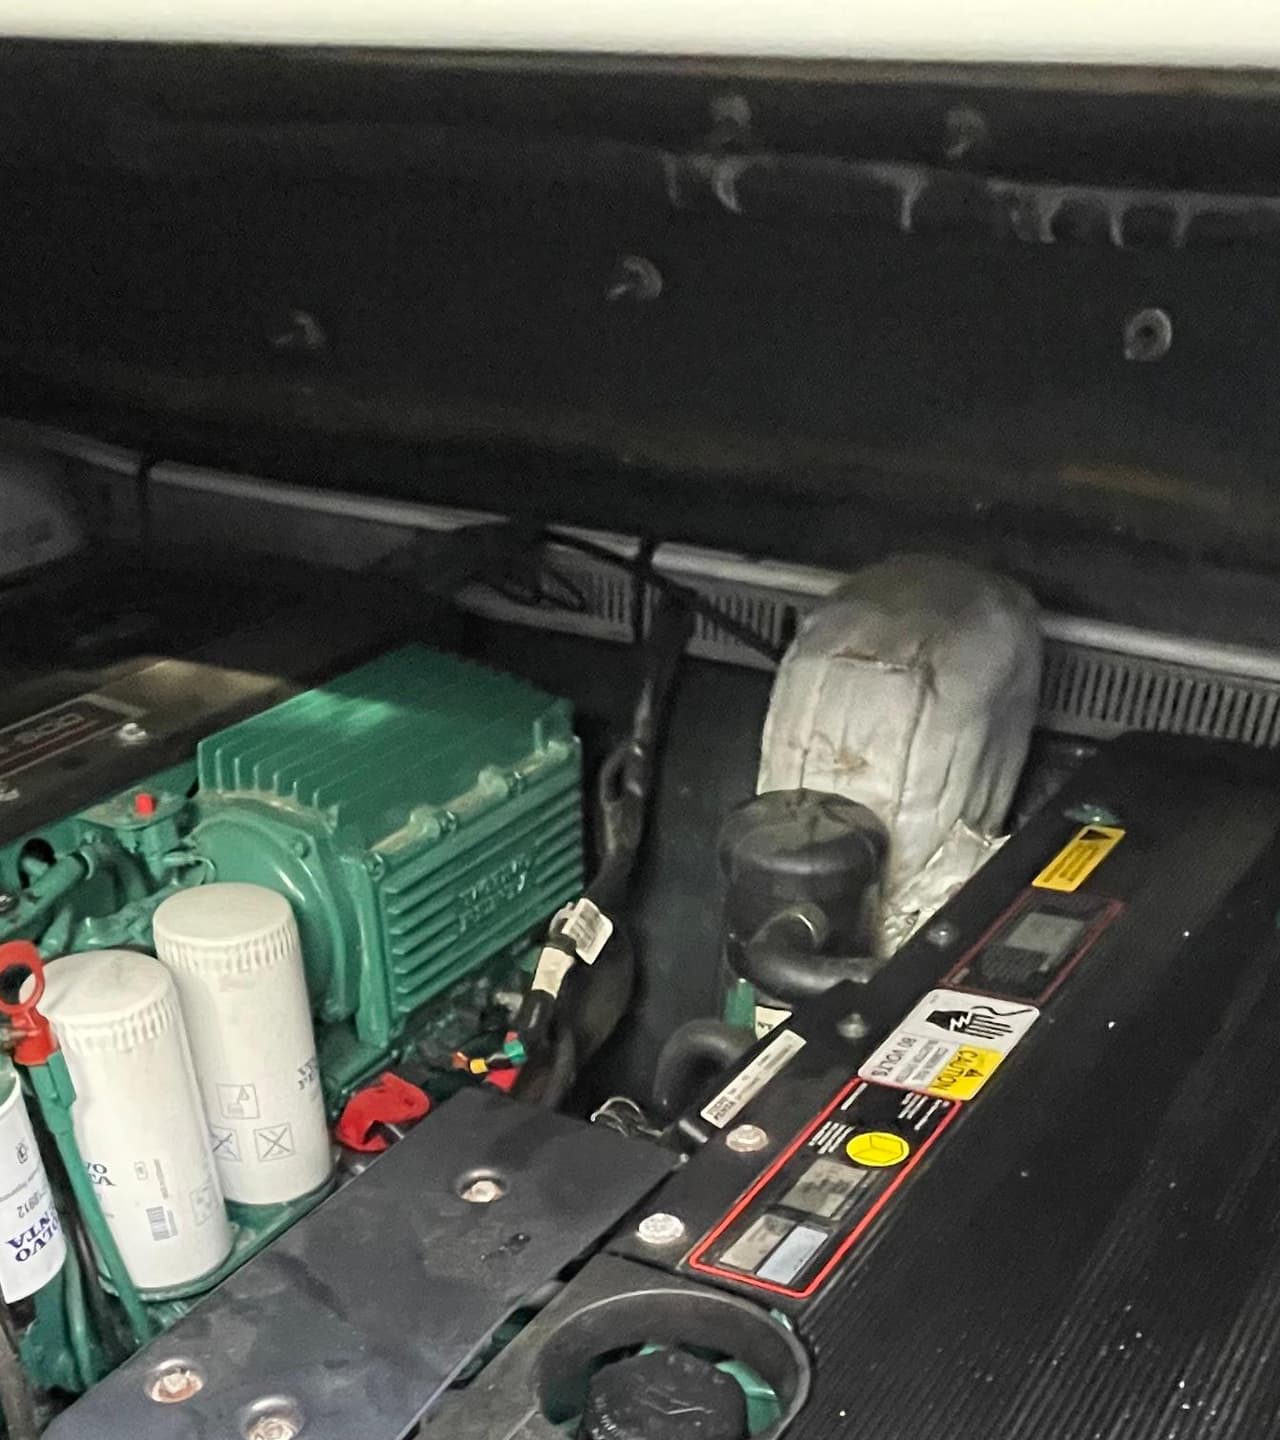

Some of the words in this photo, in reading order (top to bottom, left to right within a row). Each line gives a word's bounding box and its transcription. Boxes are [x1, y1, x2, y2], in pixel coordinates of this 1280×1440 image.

[932, 1050, 979, 1091] CAUTION
[3, 1206, 54, 1250] NTA
[14, 1214, 59, 1263] OLVO
